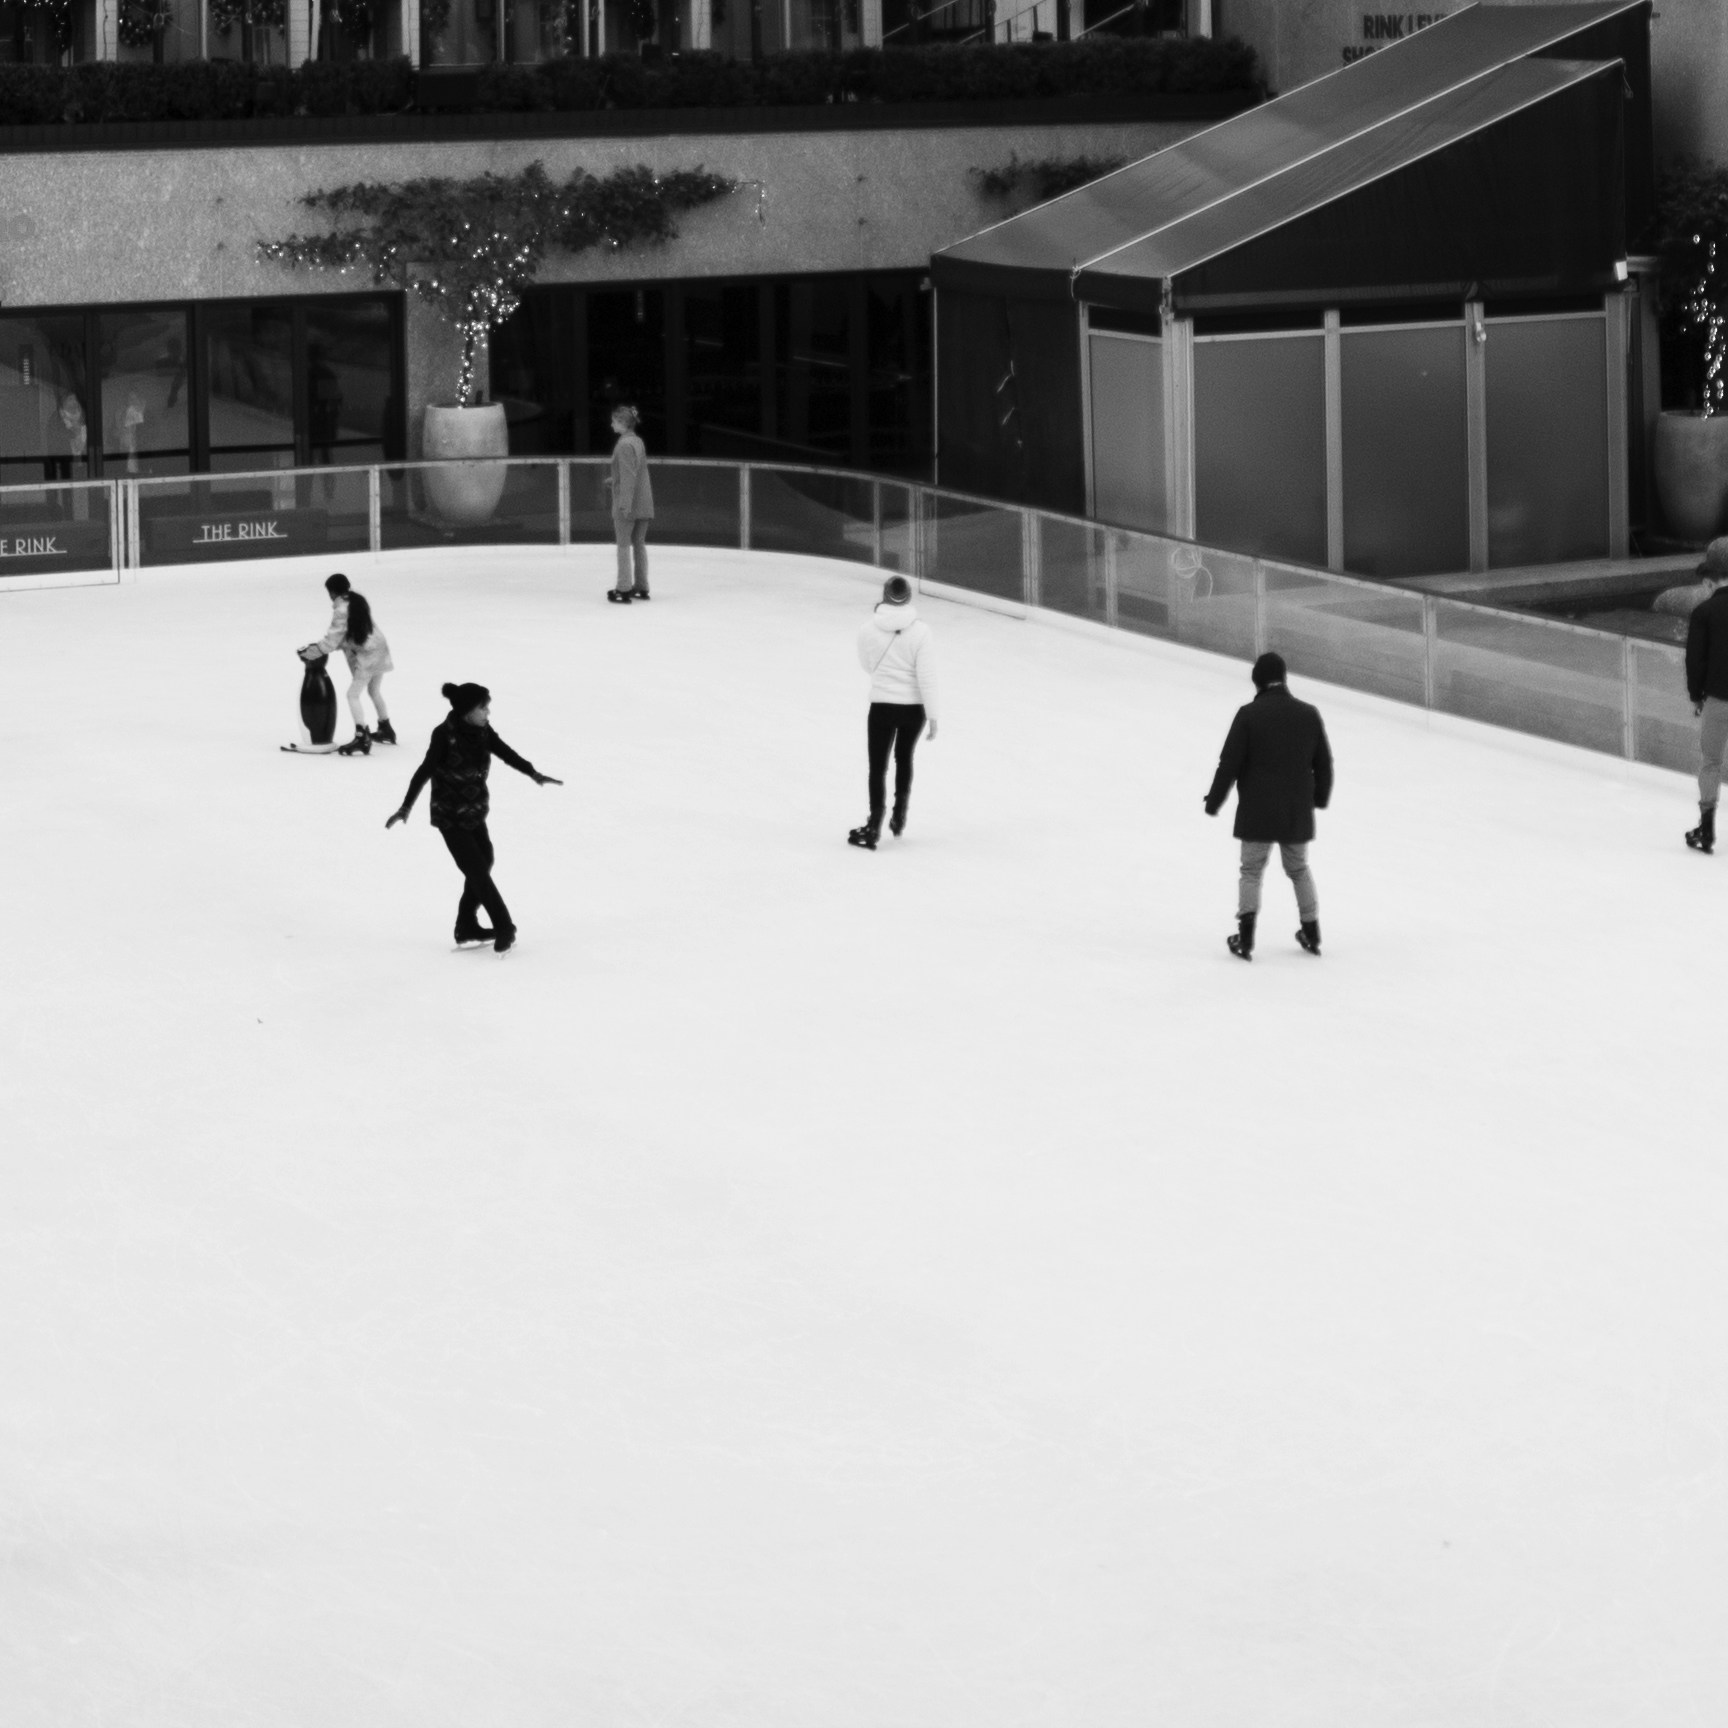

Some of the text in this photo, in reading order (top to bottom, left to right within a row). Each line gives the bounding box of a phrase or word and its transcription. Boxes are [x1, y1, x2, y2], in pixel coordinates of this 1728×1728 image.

[1363, 14, 1404, 39] RINK
[201, 520, 278, 541] THE RINK
[15, 536, 58, 555] RINK
